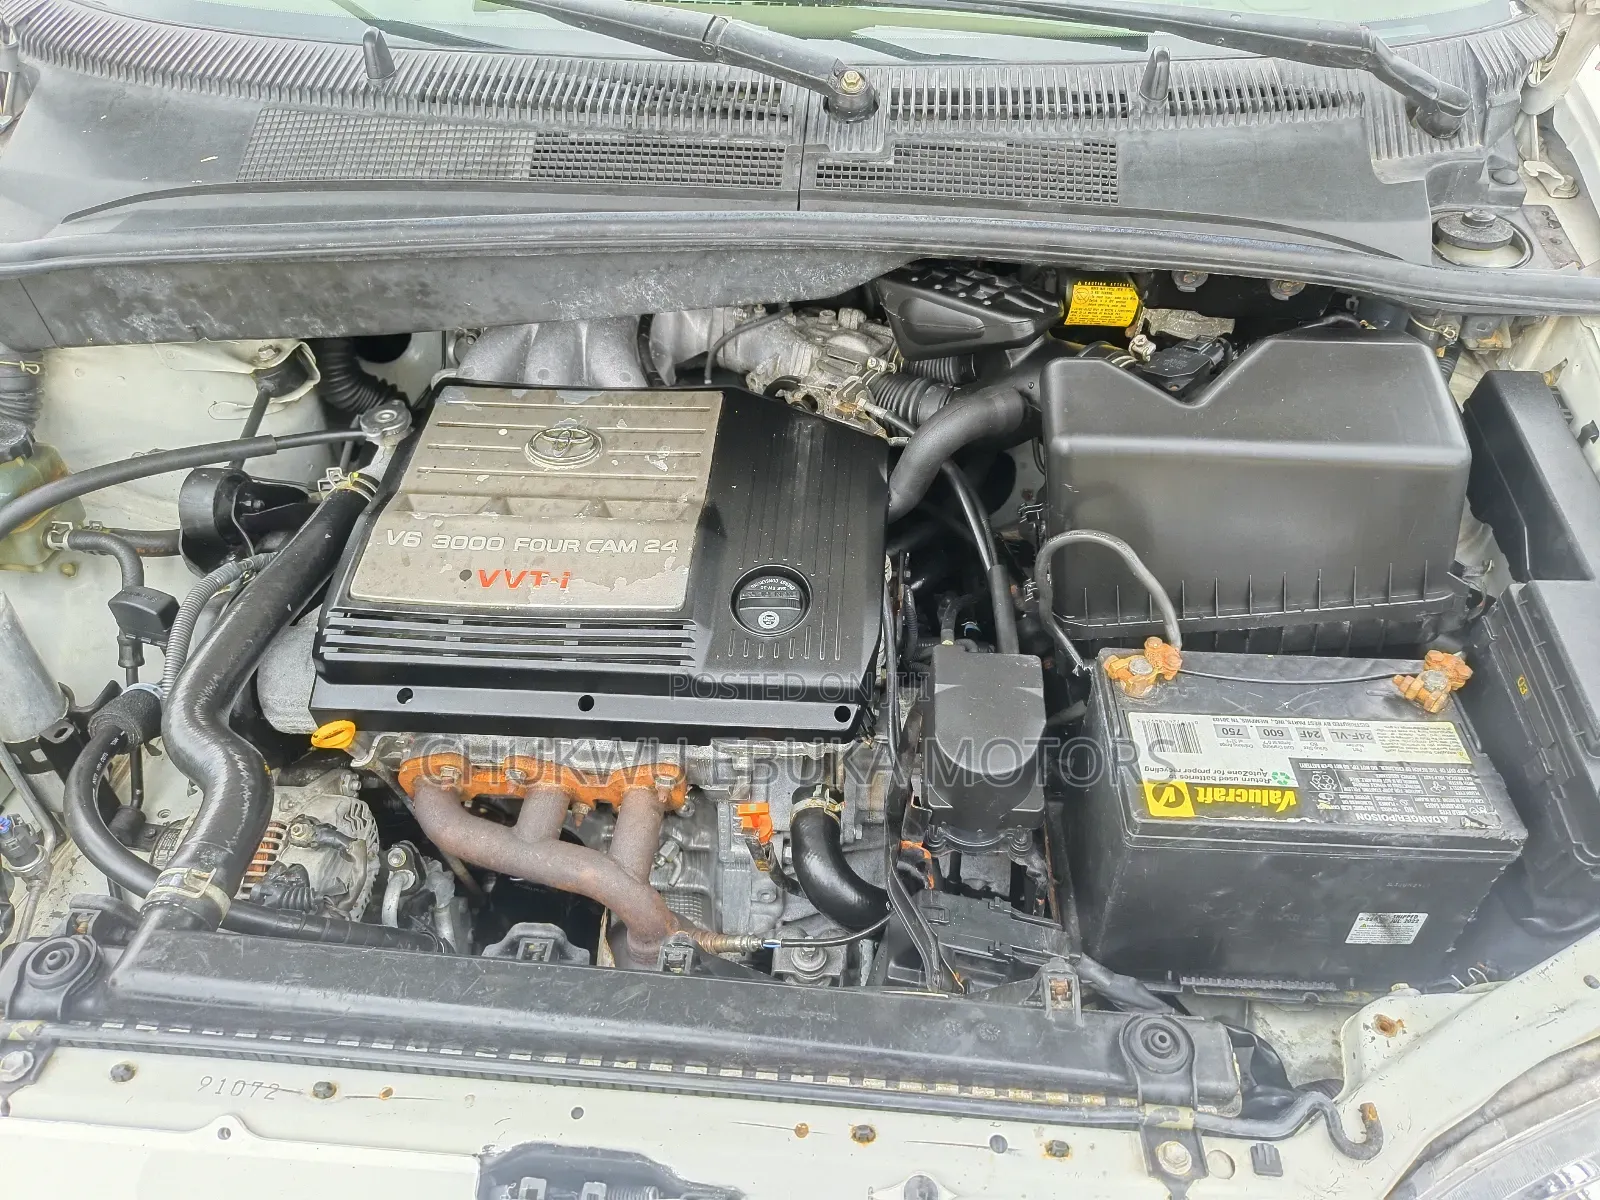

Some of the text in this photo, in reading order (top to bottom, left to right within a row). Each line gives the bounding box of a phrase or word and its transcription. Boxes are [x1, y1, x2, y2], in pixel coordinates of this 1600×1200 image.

[386, 528, 679, 555] V6 3000 FOUR CAM 24
[1221, 727, 1243, 737] 750
[1262, 728, 1284, 738] 600
[1299, 730, 1321, 739] 24F
[1330, 731, 1373, 741] 24F-VL
[1144, 765, 1182, 774] recycling
[1183, 767, 1211, 775] proper
[1227, 769, 1268, 777] AutoZone
[1179, 774, 1217, 782] batteries
[1218, 775, 1239, 783] used
[1242, 776, 1269, 784] Return
[1194, 786, 1297, 813] Valucraft
[197, 1075, 280, 1101] 91072
